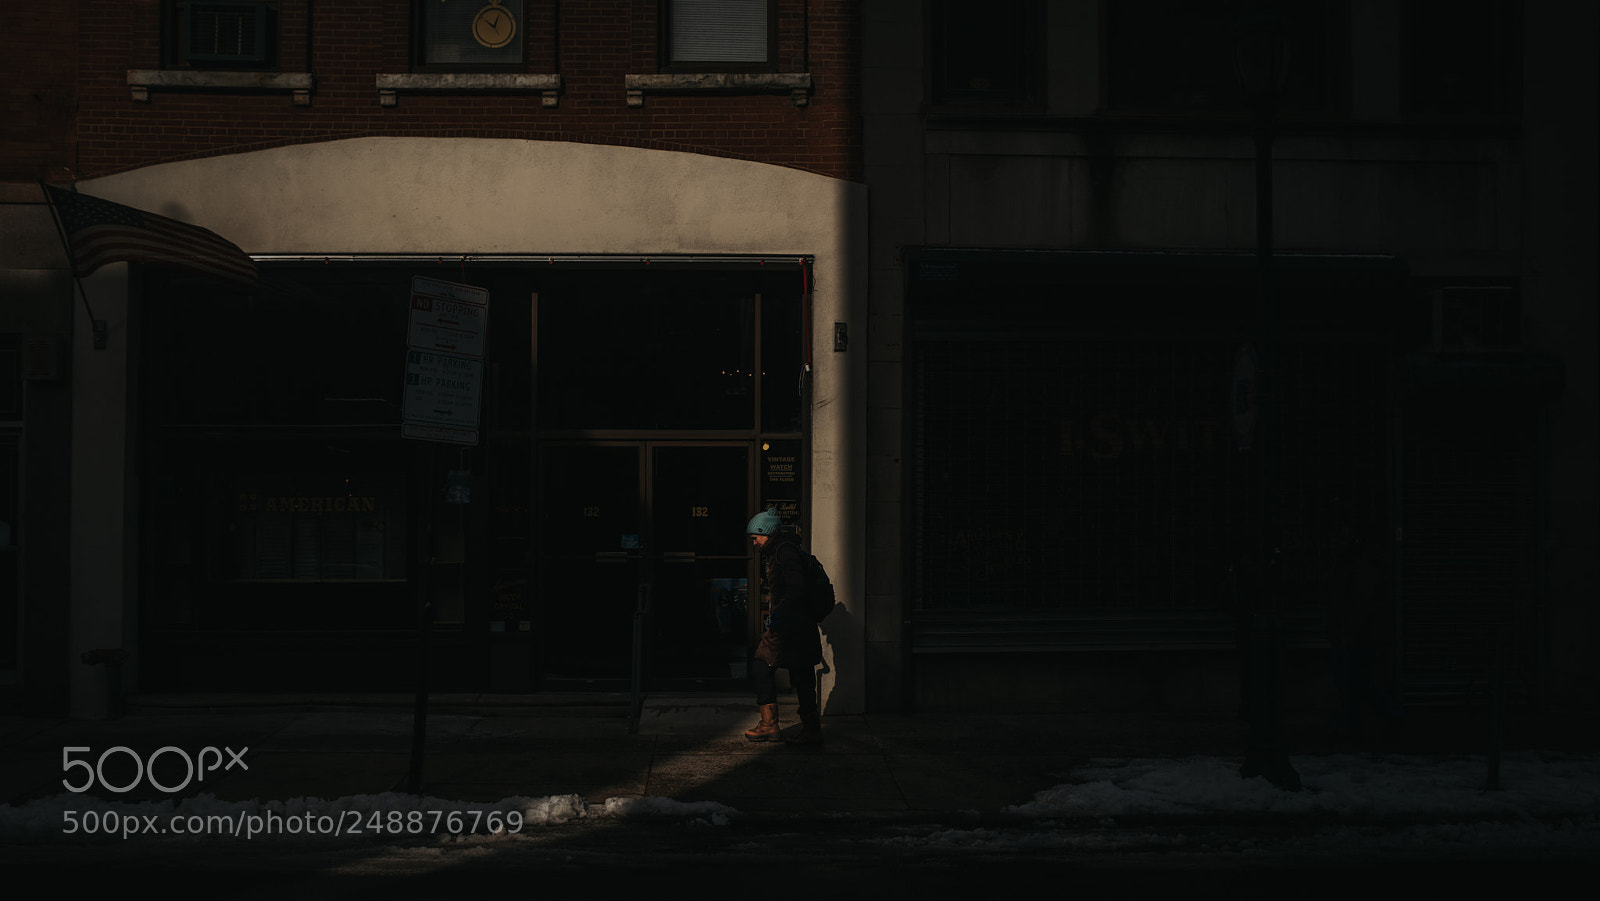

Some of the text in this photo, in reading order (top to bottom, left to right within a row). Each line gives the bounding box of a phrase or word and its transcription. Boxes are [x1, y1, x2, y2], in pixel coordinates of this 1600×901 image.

[416, 297, 430, 308] NO
[435, 302, 480, 318] STOPPING
[437, 357, 473, 370] PARKING
[421, 375, 432, 385] HR
[436, 378, 471, 391] PARKING
[265, 496, 376, 512] AMERICAN
